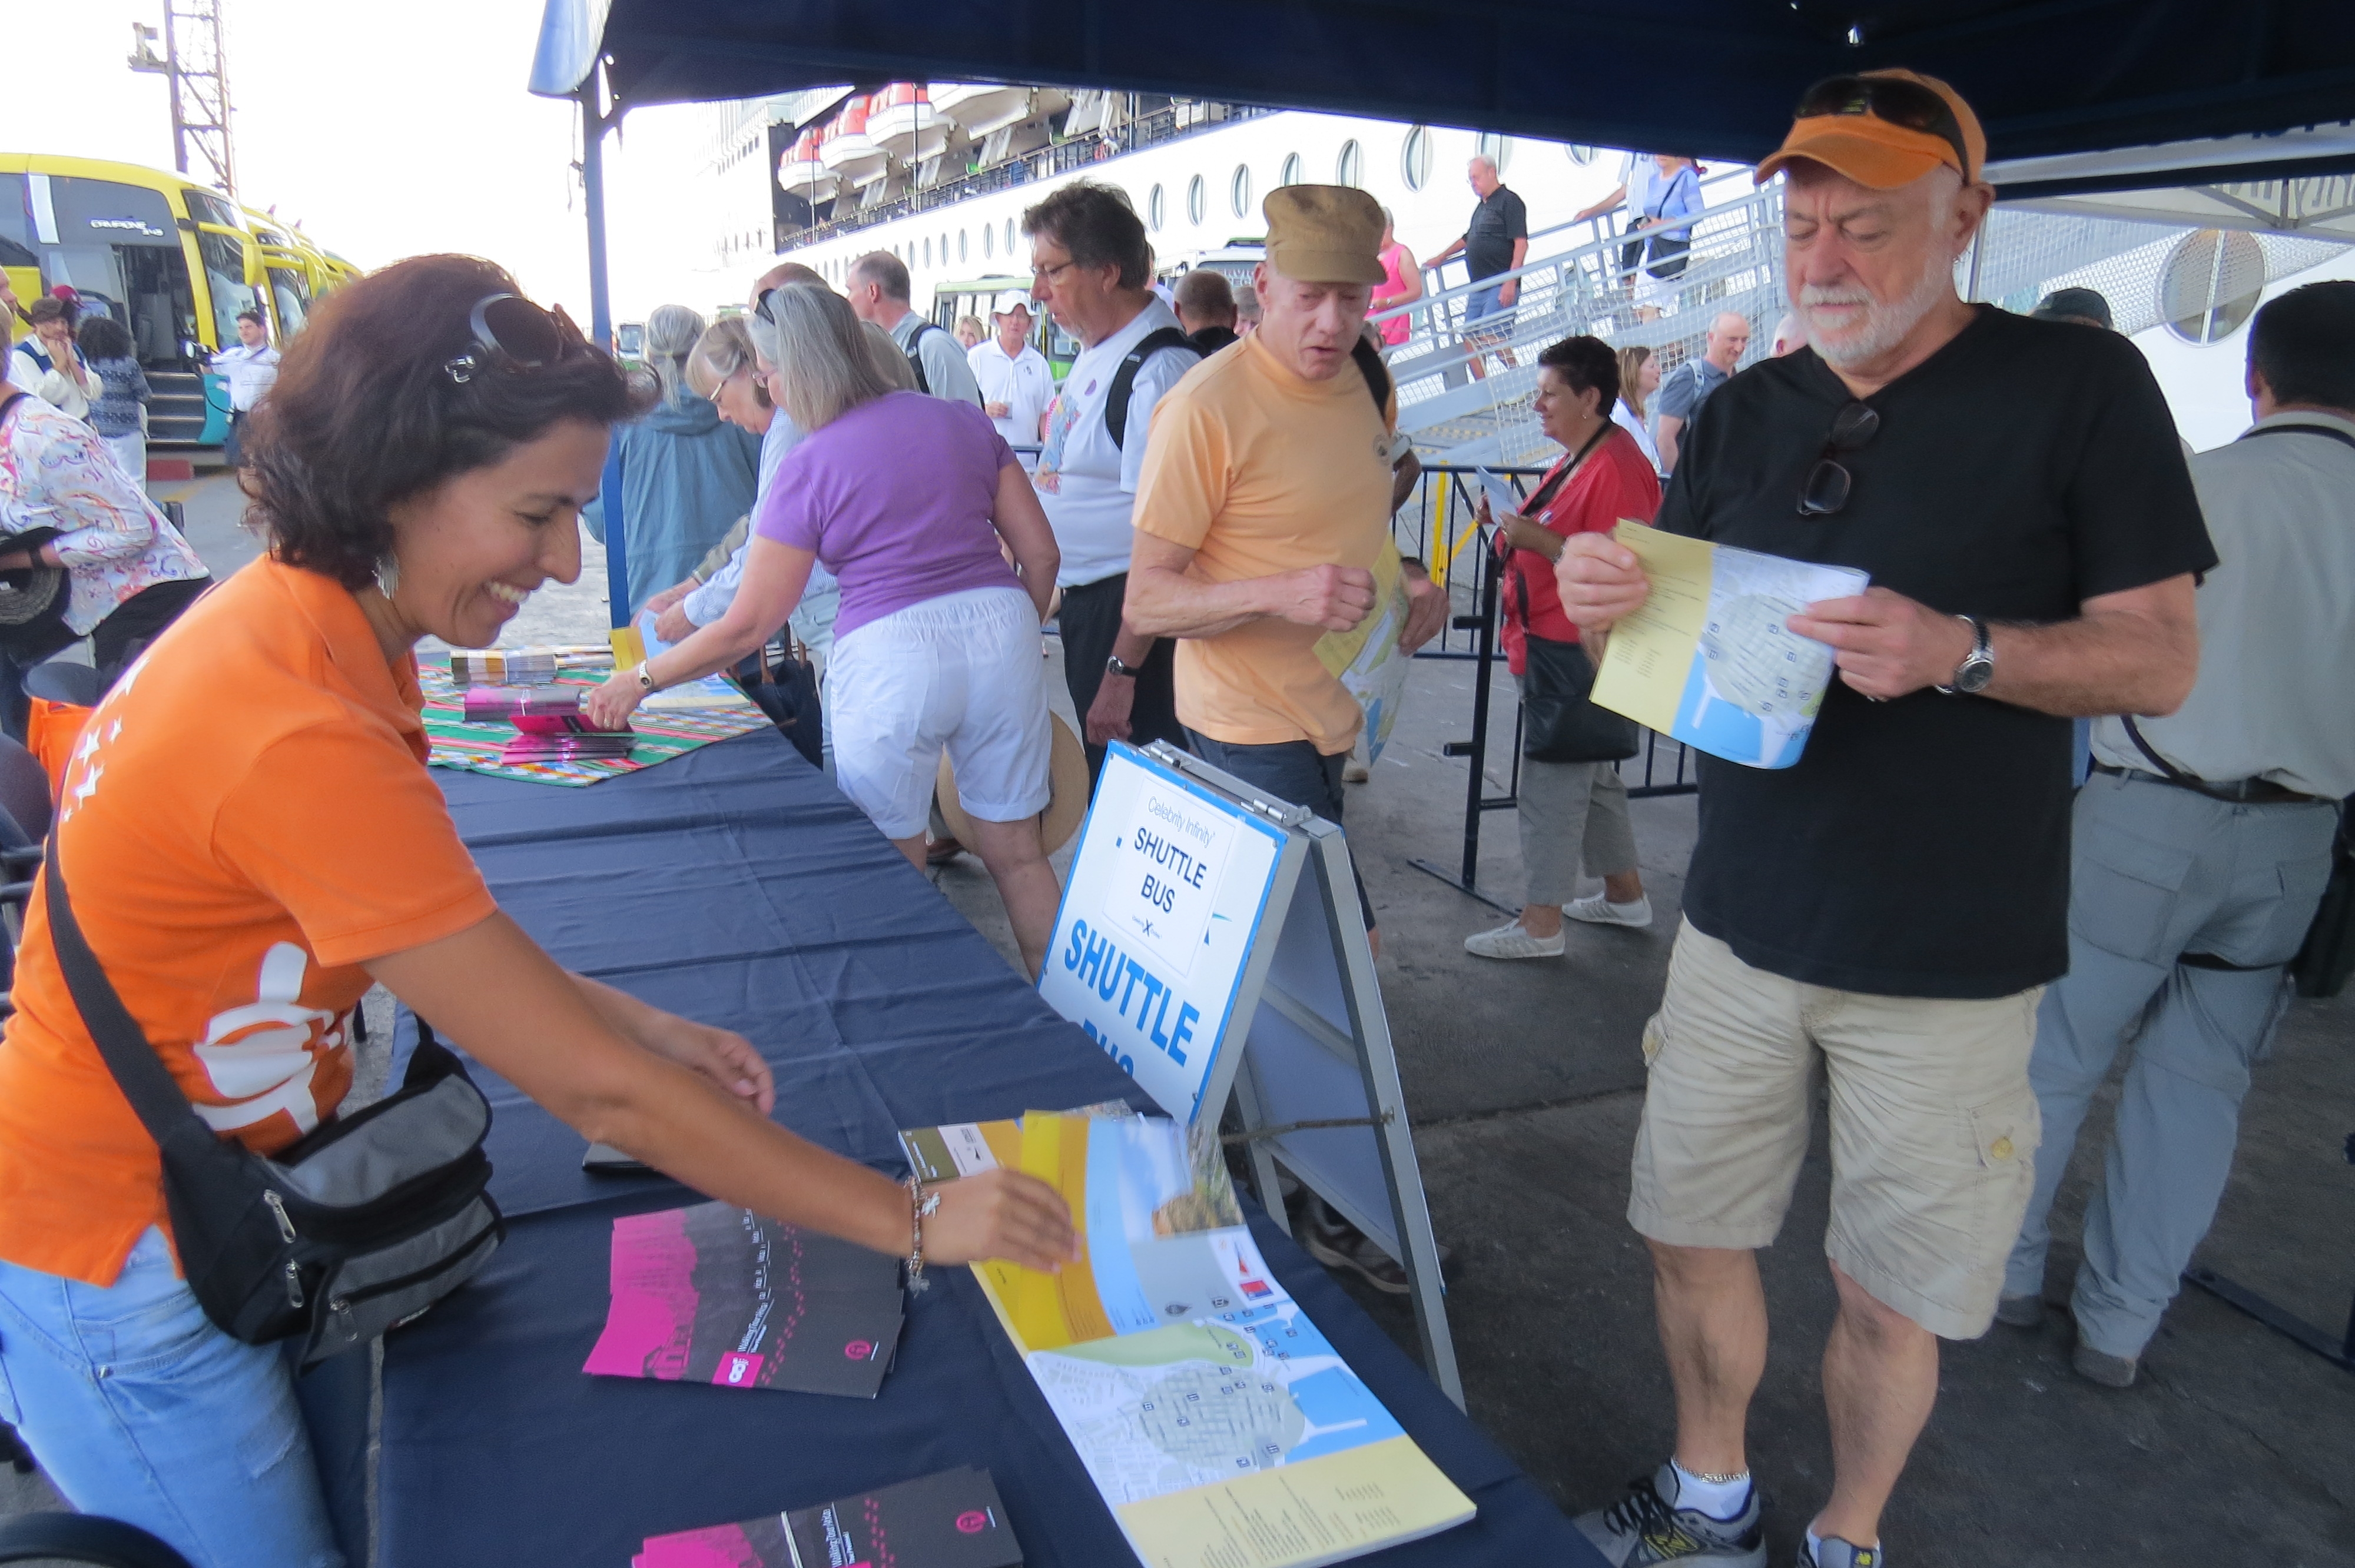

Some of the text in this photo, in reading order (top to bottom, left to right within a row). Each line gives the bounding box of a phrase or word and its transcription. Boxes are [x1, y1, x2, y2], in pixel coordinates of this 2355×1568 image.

[1148, 796, 1185, 833] Celebrity
[1134, 827, 1207, 890] SHUTTLE
[1141, 872, 1176, 913] BUS
[1064, 919, 1200, 1068] SHUTTLE
